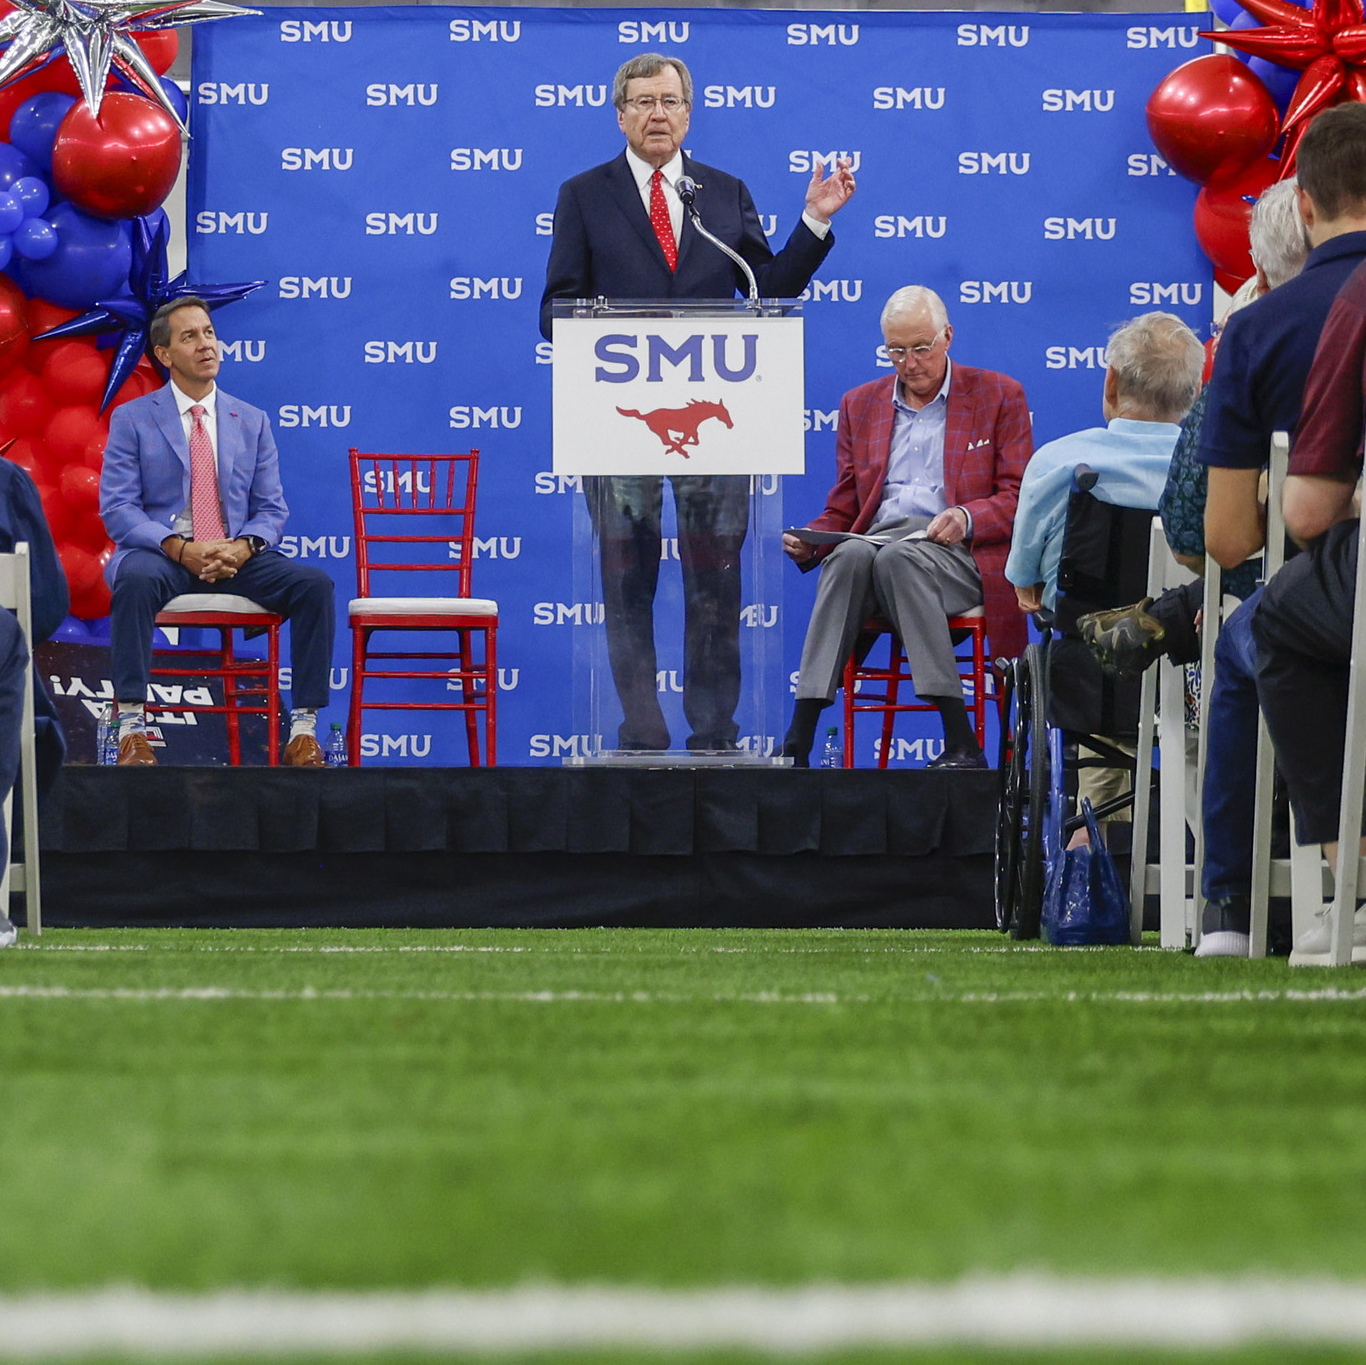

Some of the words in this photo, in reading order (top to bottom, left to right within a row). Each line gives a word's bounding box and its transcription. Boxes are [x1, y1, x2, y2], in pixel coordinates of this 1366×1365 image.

[280, 20, 352, 43] SMU
[449, 19, 521, 42] SMU
[618, 21, 689, 43] SMU
[786, 23, 859, 46] SMU
[957, 24, 1029, 47] SMU
[1126, 26, 1199, 49] SMU
[198, 83, 269, 105] SMU
[366, 84, 438, 106] SMU
[535, 84, 607, 107] SMU
[704, 85, 776, 108] SMU
[873, 87, 946, 110] SMU
[1042, 89, 1115, 112] SMU
[281, 148, 354, 171] SMU
[450, 148, 523, 171] SMU
[789, 150, 861, 173] SMU
[958, 152, 1030, 175] SMU
[1128, 153, 1177, 176] SM
[196, 211, 268, 235] SMU
[365, 212, 438, 235] SMU
[874, 215, 947, 239] SMU
[1044, 217, 1116, 240] SMU
[279, 277, 352, 299] SMU
[450, 277, 522, 300] SMU
[960, 281, 1032, 304] SMU
[1130, 283, 1202, 305] SMU
[217, 340, 266, 362] MU
[364, 341, 437, 364] SMU
[593, 334, 759, 385] SMU
[279, 405, 352, 428] SMU
[449, 406, 522, 429] SMU
[364, 470, 431, 494] SMU
[535, 472, 584, 494] SM
[278, 535, 351, 558] SMU
[448, 536, 522, 560] SMU
[277, 667, 349, 691] SU
[360, 733, 433, 757] SMU
[873, 738, 946, 761] SMU
